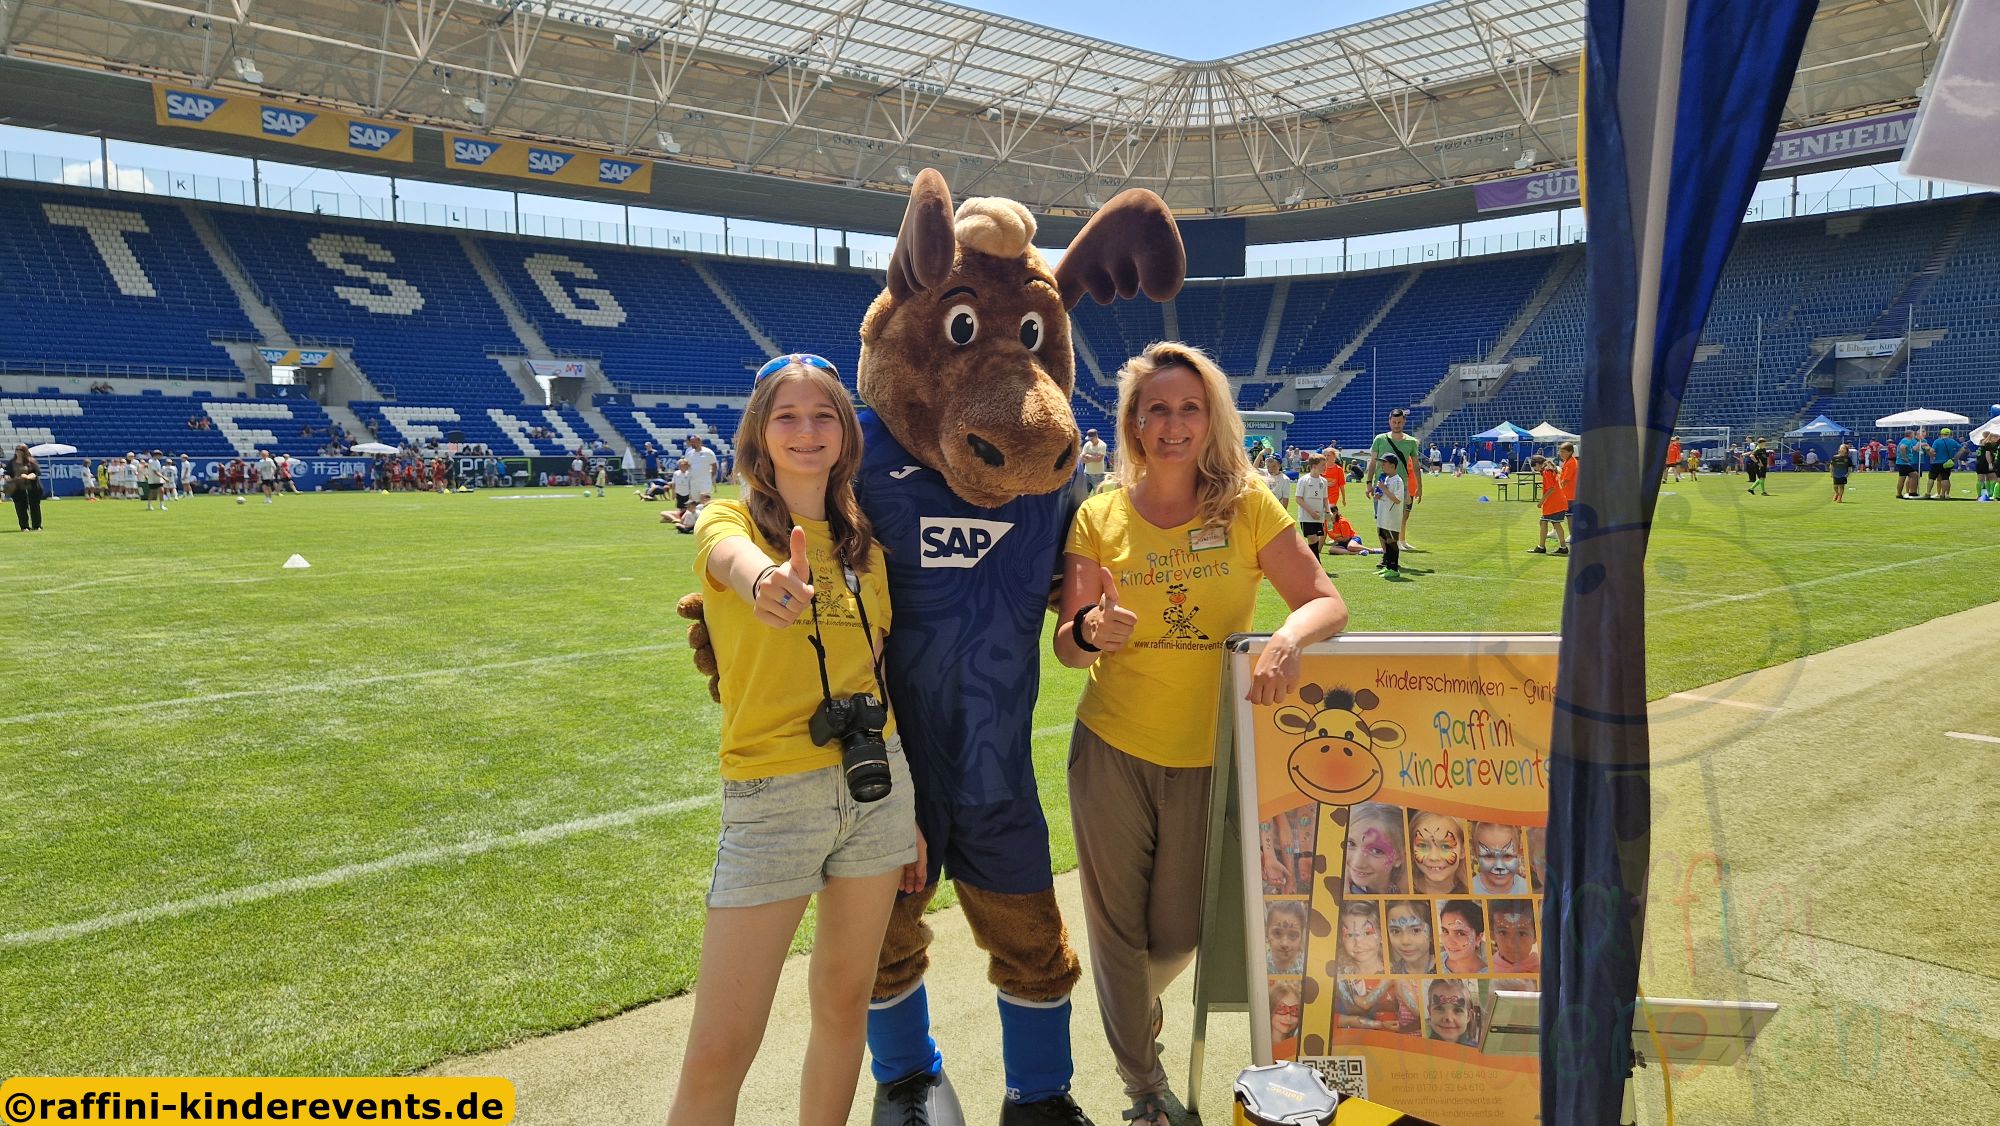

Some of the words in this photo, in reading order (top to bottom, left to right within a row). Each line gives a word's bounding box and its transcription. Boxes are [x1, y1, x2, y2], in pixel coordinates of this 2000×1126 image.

[166, 94, 215, 118] SAP
[262, 110, 306, 134] SAP
[349, 125, 390, 148] SAP
[454, 141, 491, 162] SAP
[528, 152, 564, 172] SAP
[599, 161, 632, 182] SAP
[176, 179, 187, 190] K
[452, 211, 460, 222] L
[1539, 234, 1546, 242] R
[301, 352, 324, 365] SAP
[921, 525, 992, 559] SAP
[1146, 548, 1201, 568] Raffini
[1119, 560, 1230, 587] Kinderevents
[1375, 668, 1505, 697] Kinderschminken
[1433, 709, 1515, 750] Raffini
